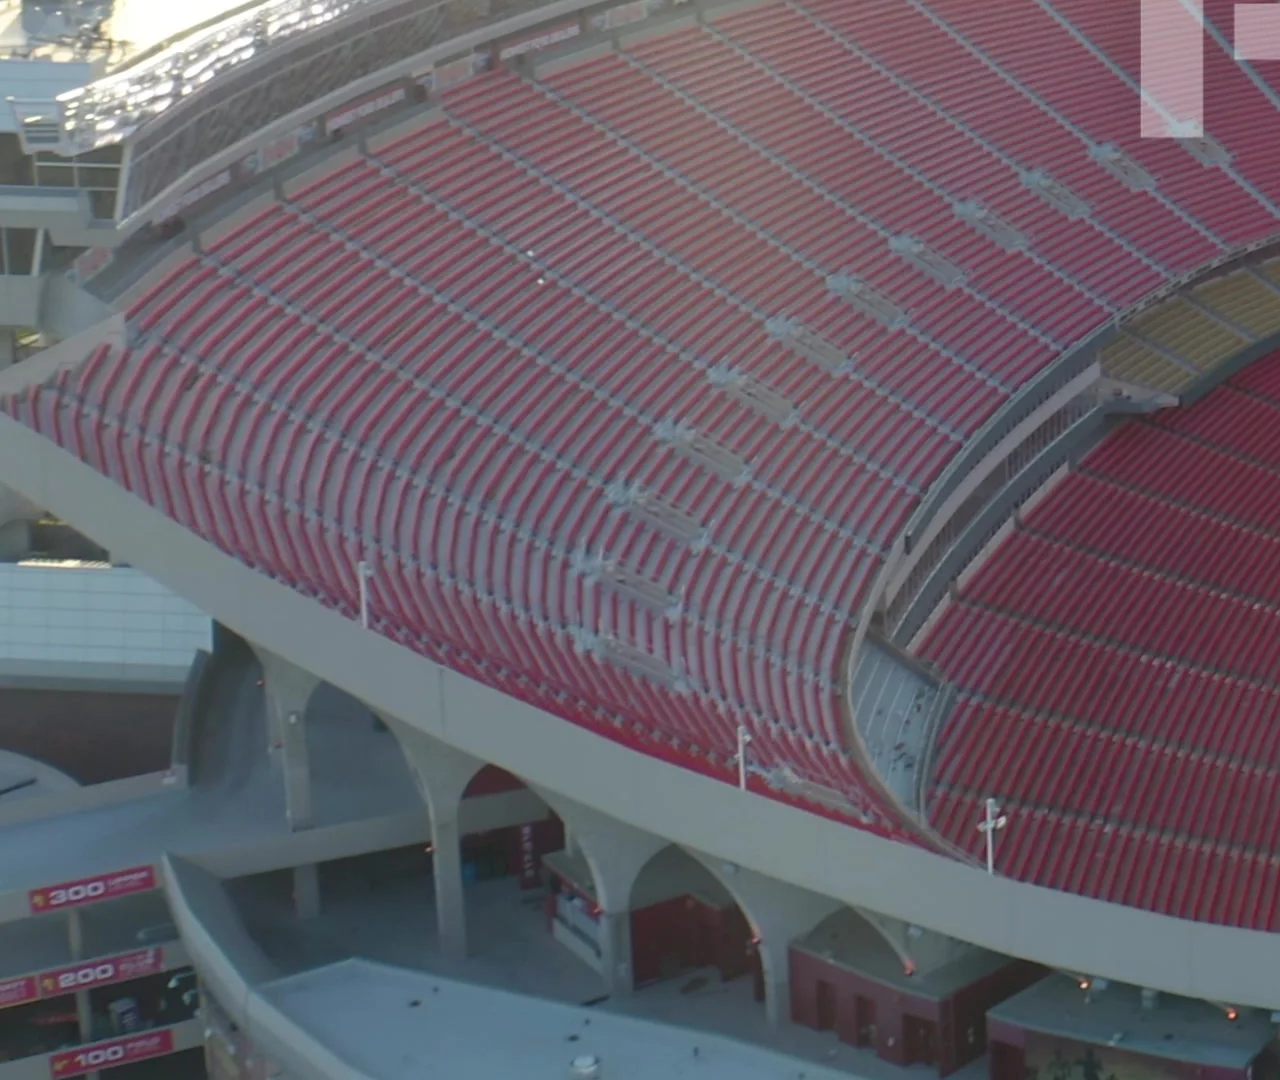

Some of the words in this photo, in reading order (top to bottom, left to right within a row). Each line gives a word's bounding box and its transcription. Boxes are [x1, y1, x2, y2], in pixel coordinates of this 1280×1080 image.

[48, 881, 106, 906] 300
[58, 963, 115, 989] 200
[74, 1045, 125, 1067] 100
